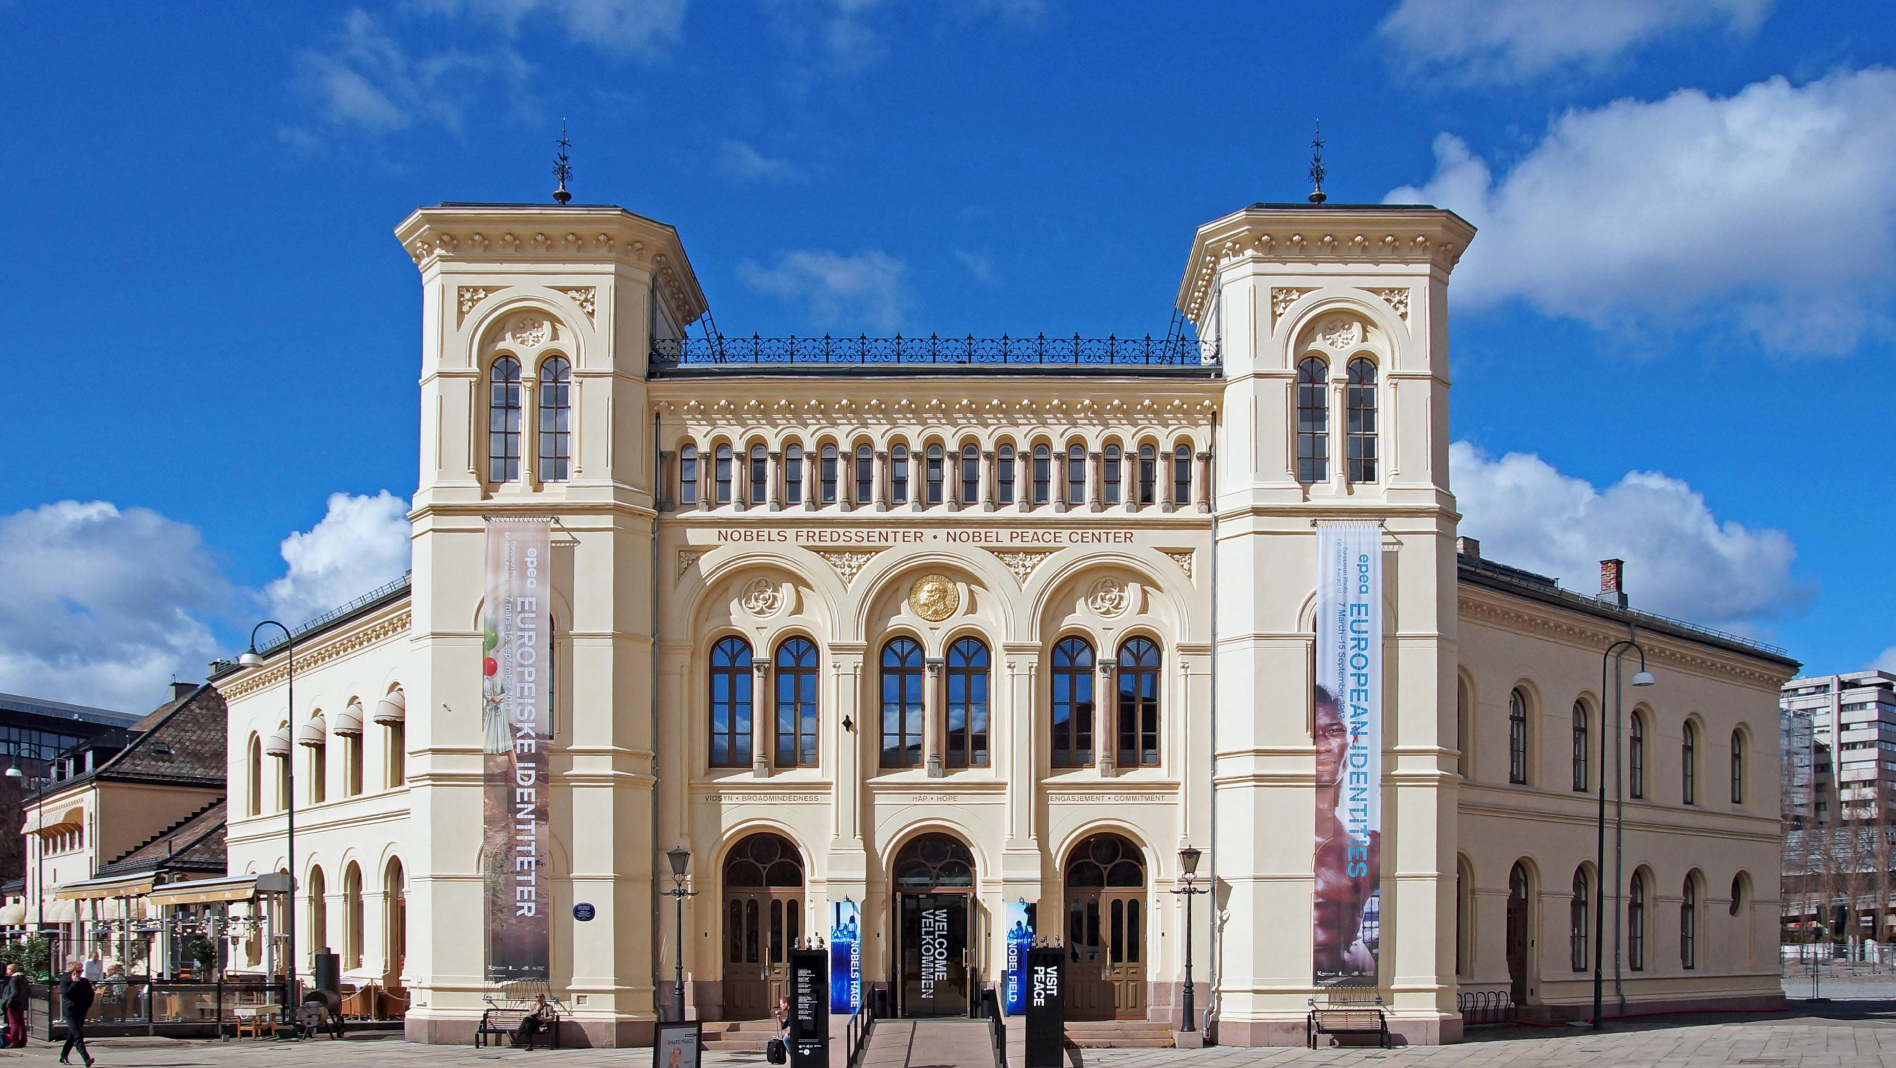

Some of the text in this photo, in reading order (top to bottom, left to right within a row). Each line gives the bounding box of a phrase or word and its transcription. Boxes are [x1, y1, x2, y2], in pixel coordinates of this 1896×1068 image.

[718, 530, 1134, 544] NOBELS FREDSSENTER NOBEL PEACE CENTER
[524, 547, 538, 589] epea
[1357, 553, 1369, 595] epea
[503, 644, 513, 689] september
[1336, 651, 1346, 698] September
[505, 690, 513, 710] 2013
[516, 597, 537, 917] EUROPEISKE IDENTITETER
[1347, 603, 1369, 878] EUROPEAN IDENTITIES
[921, 909, 934, 999] VELKOMMEN
[934, 909, 948, 981] WELCOME
[851, 940, 859, 1008] NOBELS HAGE
[1008, 939, 1018, 1002] NOBEL FIELD
[1034, 966, 1045, 1007] PEACE
[1046, 966, 1058, 996] VISIT
